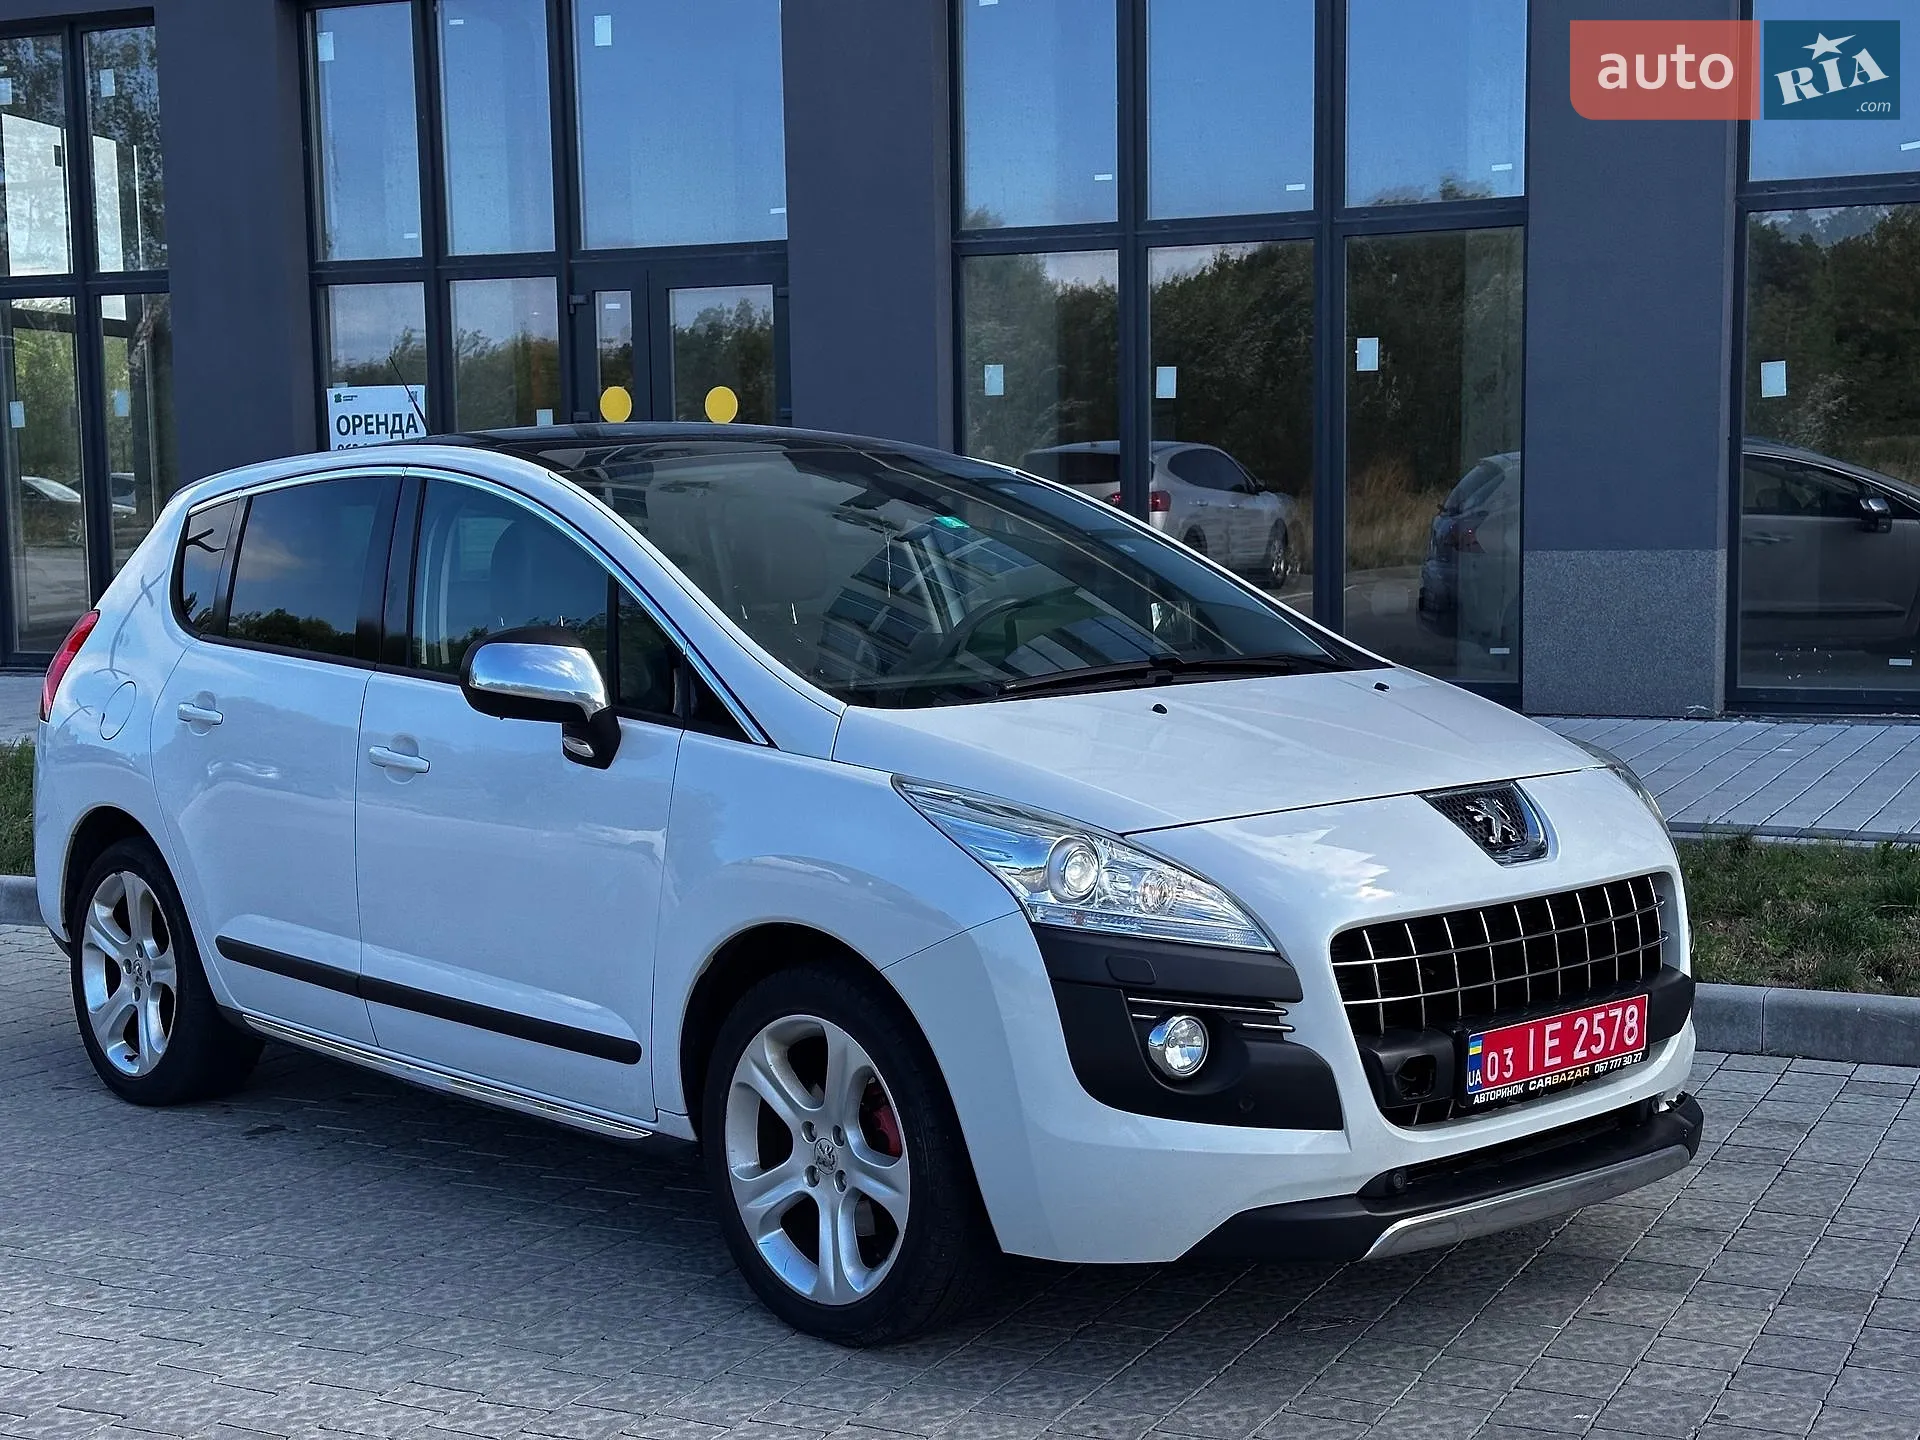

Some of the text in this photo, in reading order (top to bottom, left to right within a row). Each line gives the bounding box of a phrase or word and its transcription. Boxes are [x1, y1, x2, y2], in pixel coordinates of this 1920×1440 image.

[336, 413, 419, 439] ОРЕНДА
[1487, 1004, 1639, 1082] 03 IE 2578
[1468, 1069, 1482, 1087] UA
[1473, 1084, 1524, 1104] АВТОРИНОК
[1528, 1066, 1590, 1091] CARBAZAR
[1594, 1062, 1608, 1074] 067
